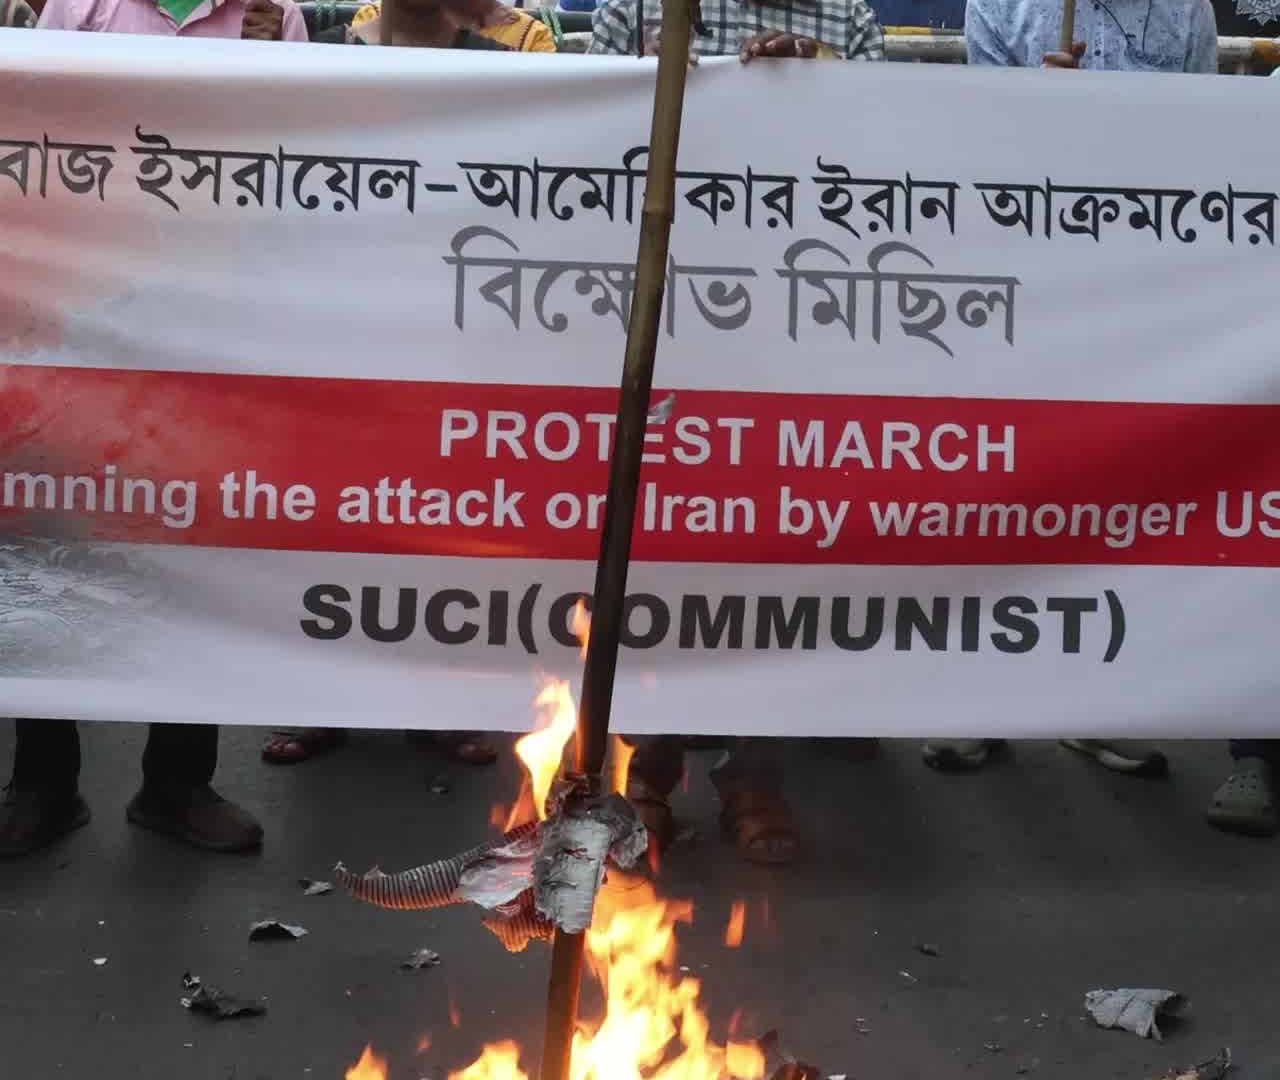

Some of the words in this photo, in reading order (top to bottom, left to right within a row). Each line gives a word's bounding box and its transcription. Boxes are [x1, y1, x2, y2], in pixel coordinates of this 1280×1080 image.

[811, 155, 959, 239] ইরান
[974, 177, 1278, 250] আক্রমণের
[776, 239, 1022, 358] মিছিল
[440, 408, 755, 467] PROTEST
[778, 422, 1016, 473] MARCH
[219, 469, 317, 520] the
[337, 478, 525, 527] attack
[644, 481, 757, 534] Iran
[778, 488, 848, 549] by
[871, 497, 1197, 550] warmonger
